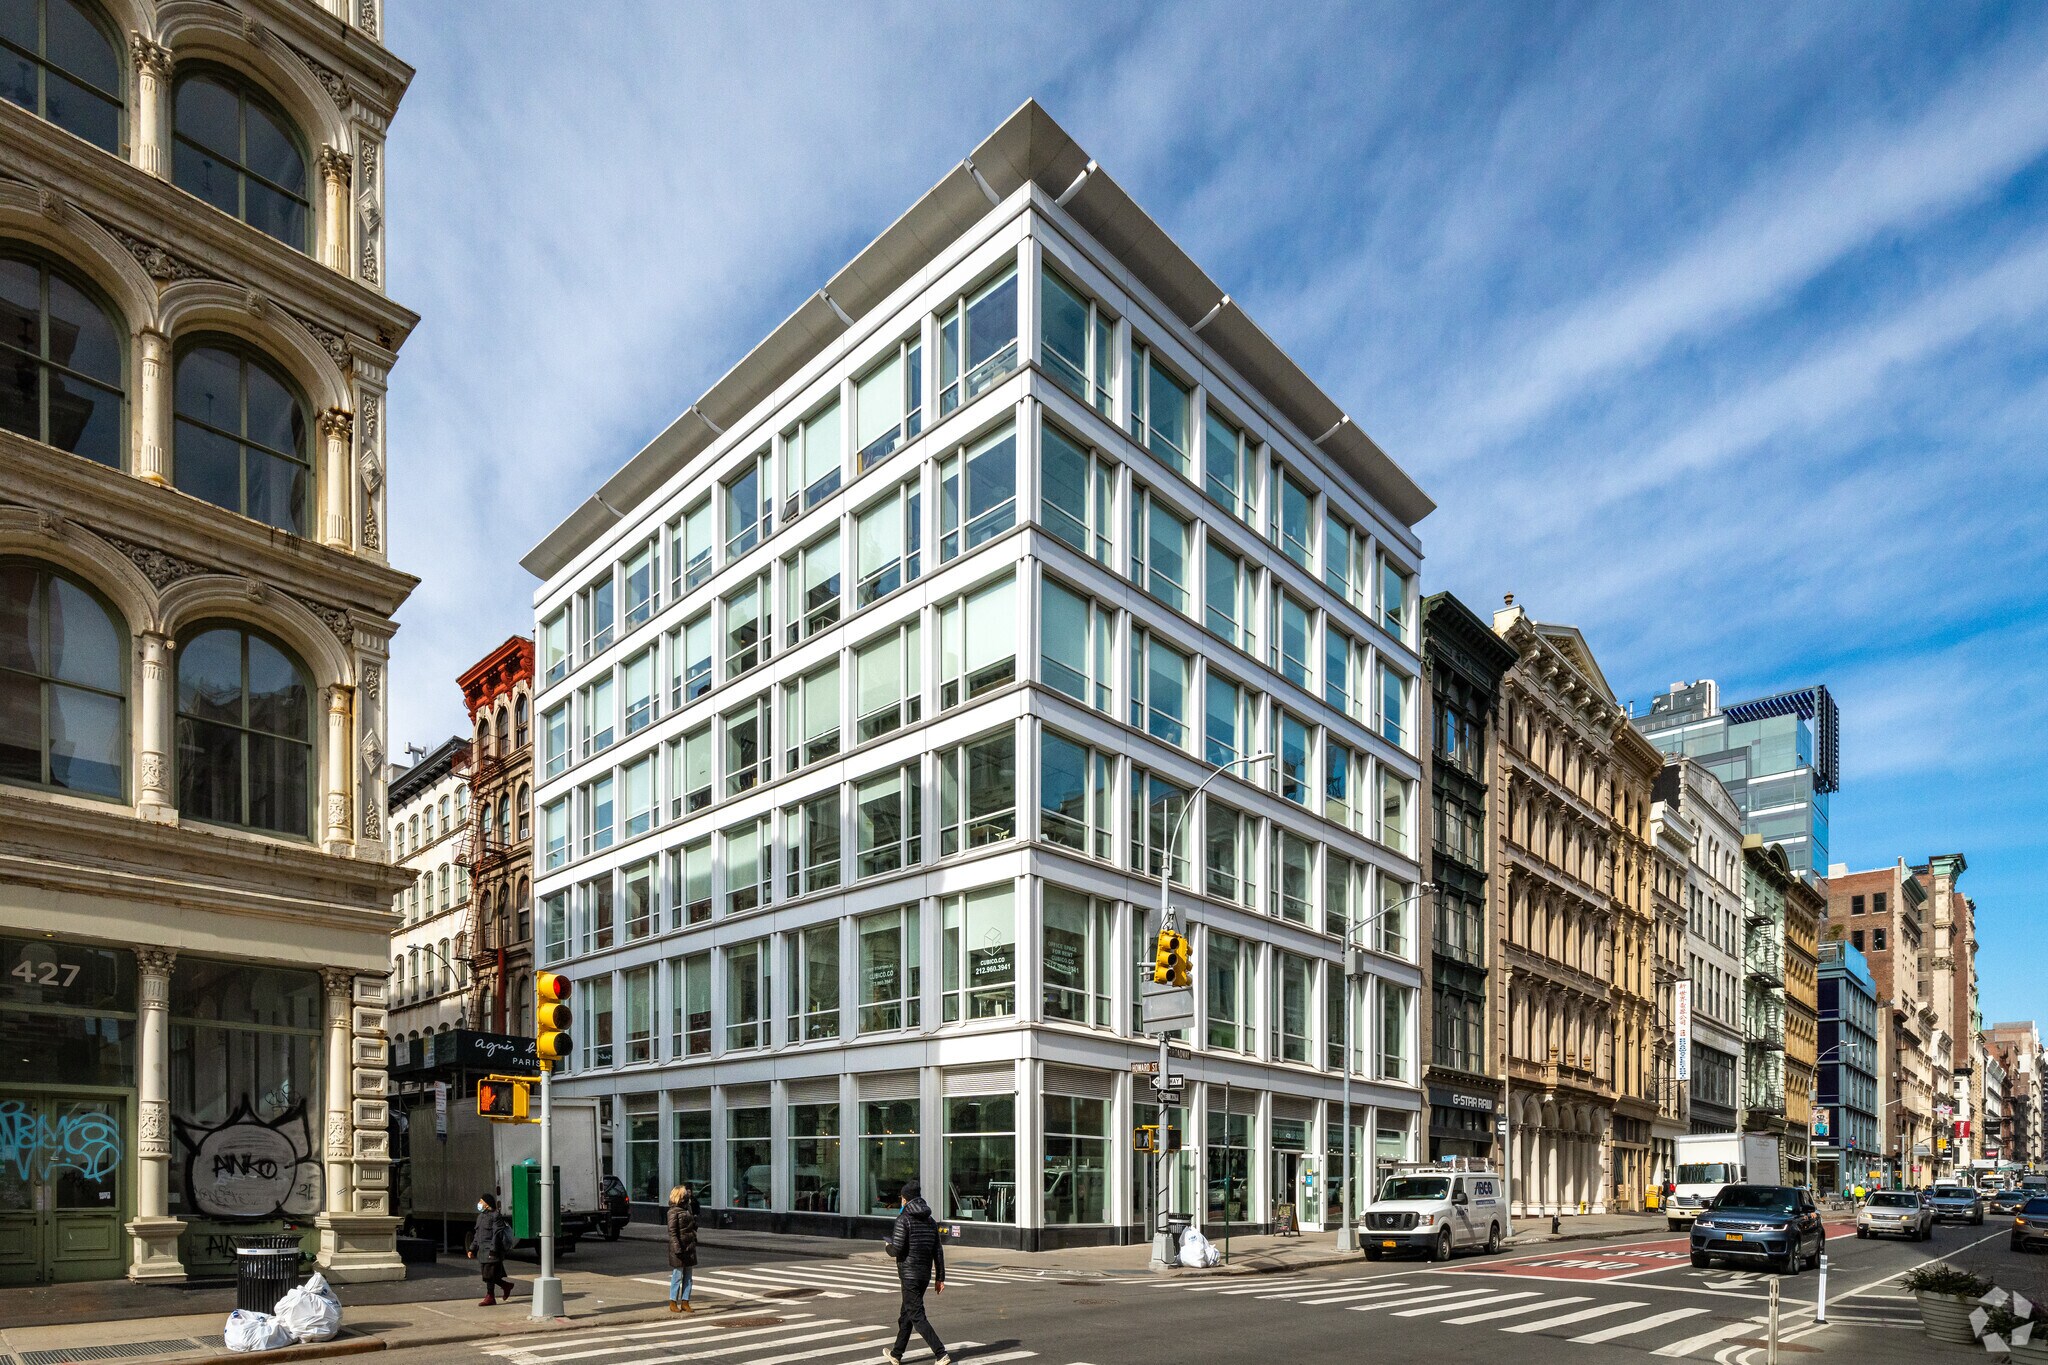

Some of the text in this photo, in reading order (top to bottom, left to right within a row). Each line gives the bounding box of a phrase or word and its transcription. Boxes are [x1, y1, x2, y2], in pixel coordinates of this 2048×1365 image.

[980, 957, 1005, 966] CUBICO.CO
[11, 960, 80, 987] 427
[975, 963, 1011, 975] 212.960.3941
[475, 1038, 514, 1057] agnès
[512, 1057, 541, 1067] PARIS
[1132, 1063, 1158, 1072] HOWARD ST
[1452, 1094, 1492, 1109] G-STAR RAW
[1474, 1181, 1493, 1195] ABCO
[1513, 1259, 1640, 1270] ONLY
